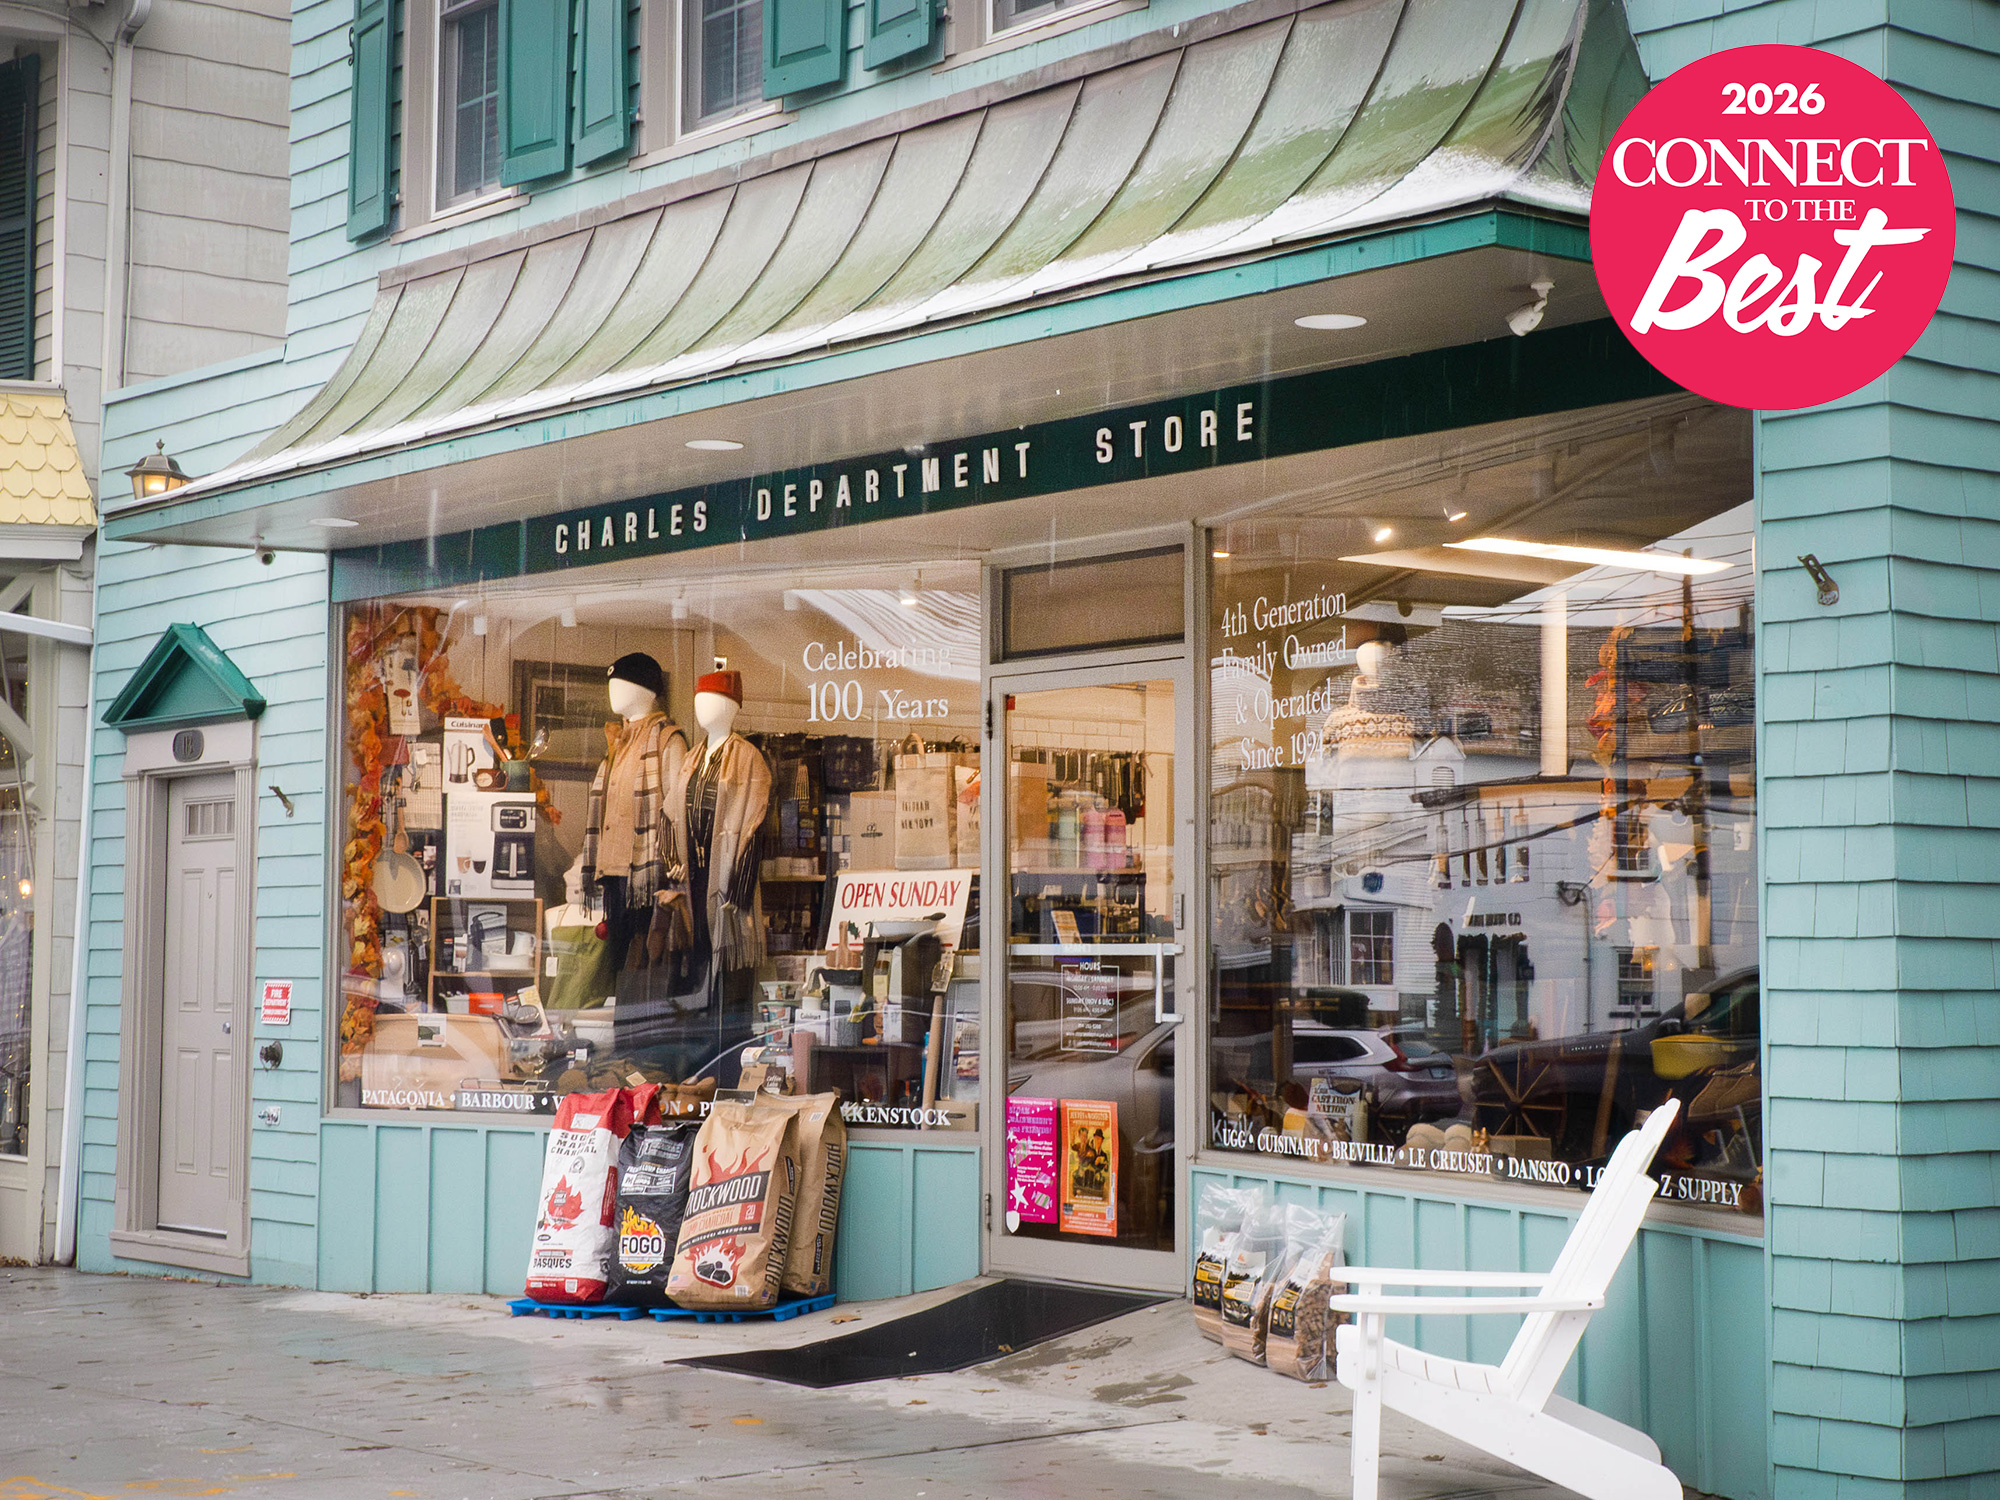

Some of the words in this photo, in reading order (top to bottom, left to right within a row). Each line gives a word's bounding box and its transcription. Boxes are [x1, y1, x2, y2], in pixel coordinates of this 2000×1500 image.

[555, 500, 707, 554] CHARLES
[757, 442, 1031, 521] DEPARTMENT
[1095, 402, 1253, 463] STORE
[1220, 603, 1248, 638] 4th
[1253, 584, 1347, 632] Generation
[802, 637, 950, 672] Celebrating
[1221, 642, 1278, 683] Family
[1283, 626, 1347, 671] Owned
[806, 680, 863, 722] 100
[879, 689, 949, 720] Years
[1235, 694, 1248, 726] &
[1254, 677, 1332, 731] Operated
[451, 720, 485, 728] Cuisinar
[1241, 736, 1284, 771] Since
[1290, 731, 1324, 766] 1924
[841, 882, 886, 909] OPEN
[889, 880, 961, 908] SUNDAY
[1079, 962, 1101, 971] HOURS
[361, 1089, 445, 1106] PATAGONIA
[461, 1090, 536, 1110] BARBOUR
[1316, 1104, 1347, 1113] NATION
[1222, 1128, 1247, 1148] UGG
[1257, 1132, 1320, 1157] CUISINART
[1332, 1140, 1396, 1164] BREVILLE
[1408, 1148, 1426, 1169] LE
[1429, 1149, 1494, 1174] CREUSET
[1507, 1157, 1571, 1185] DANSKO
[685, 1175, 762, 1217] ROCKWOOD
[819, 1142, 842, 1233] ROCKWOOD
[1660, 1174, 1673, 1197] Z
[1678, 1176, 1744, 1206] SUPPLY
[621, 1237, 662, 1254] FOGO
[765, 1194, 794, 1288] ROCKWOOD
